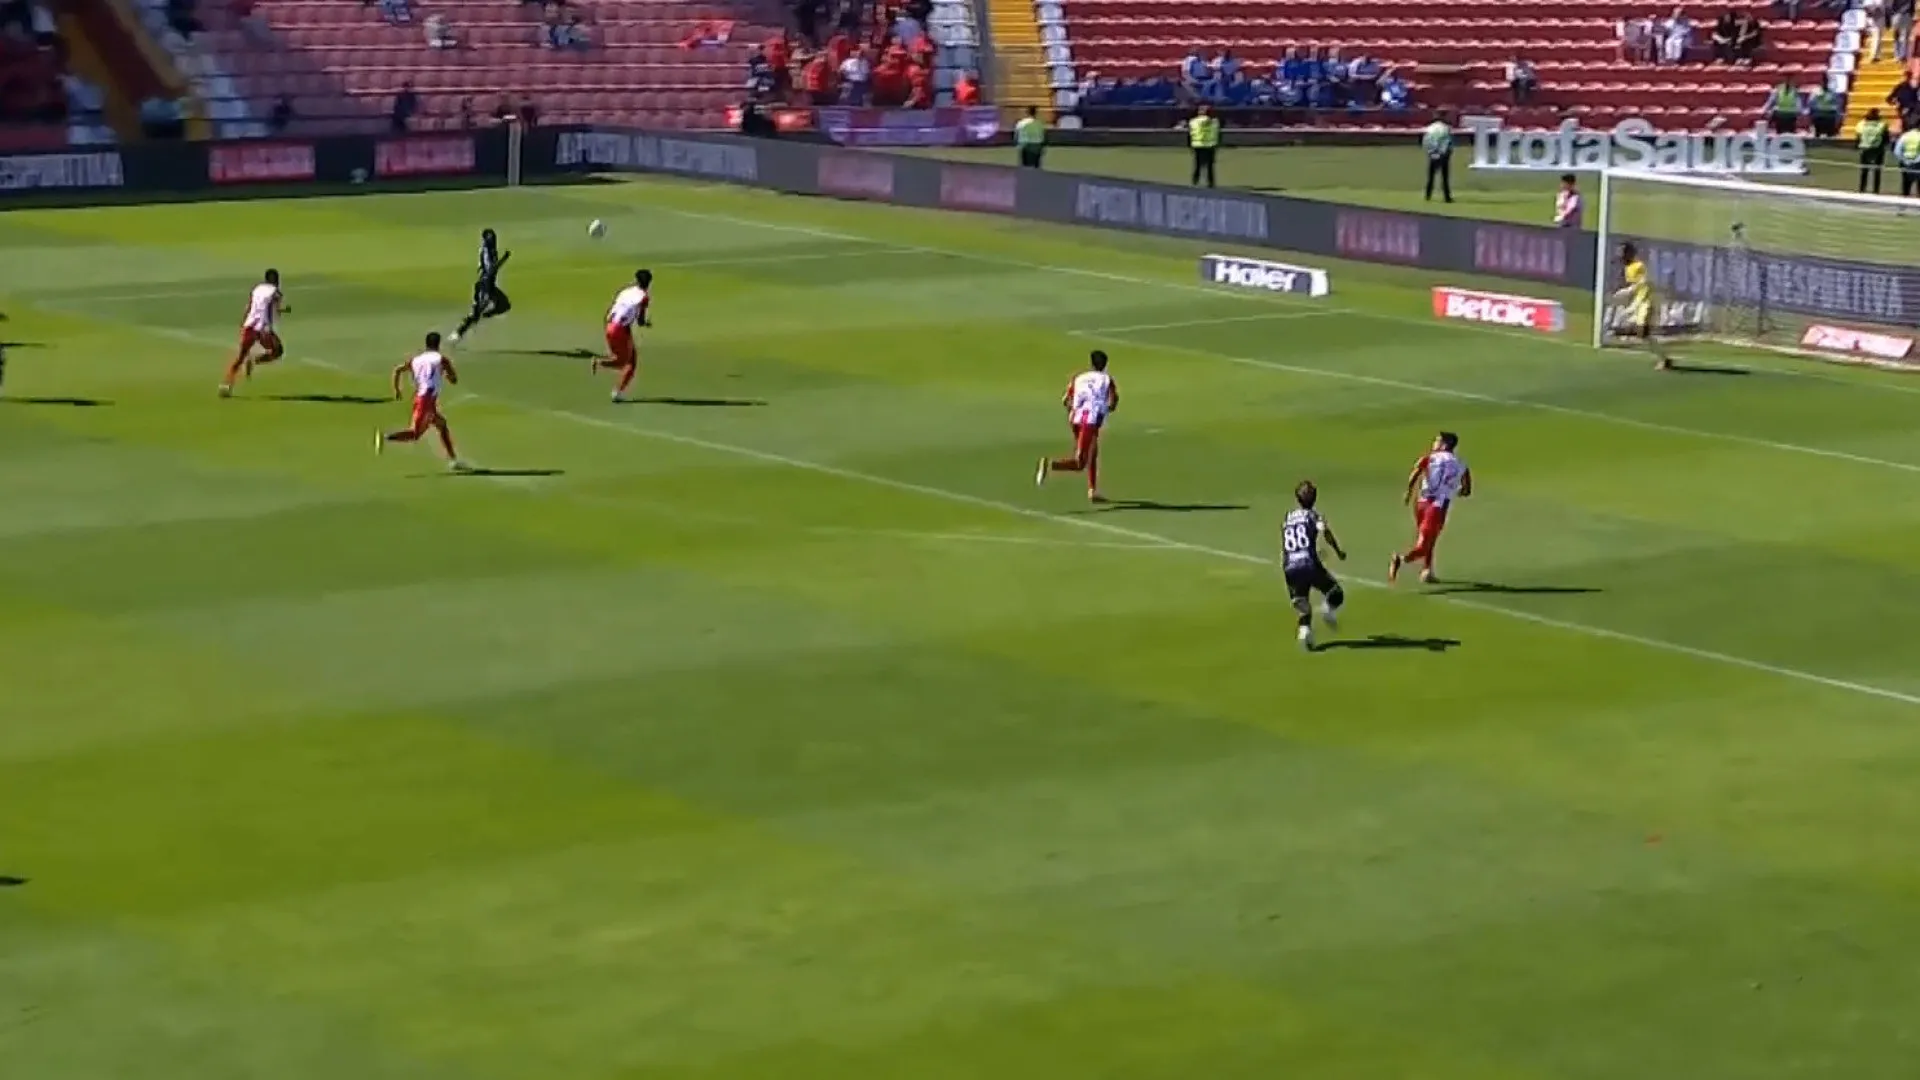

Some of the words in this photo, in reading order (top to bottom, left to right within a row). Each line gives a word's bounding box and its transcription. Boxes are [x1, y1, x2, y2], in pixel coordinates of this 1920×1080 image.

[1459, 114, 1805, 173] TrofaSaúde
[1215, 261, 1297, 291] Haier
[1446, 295, 1535, 327] Betclic
[1285, 524, 1310, 551] 88
